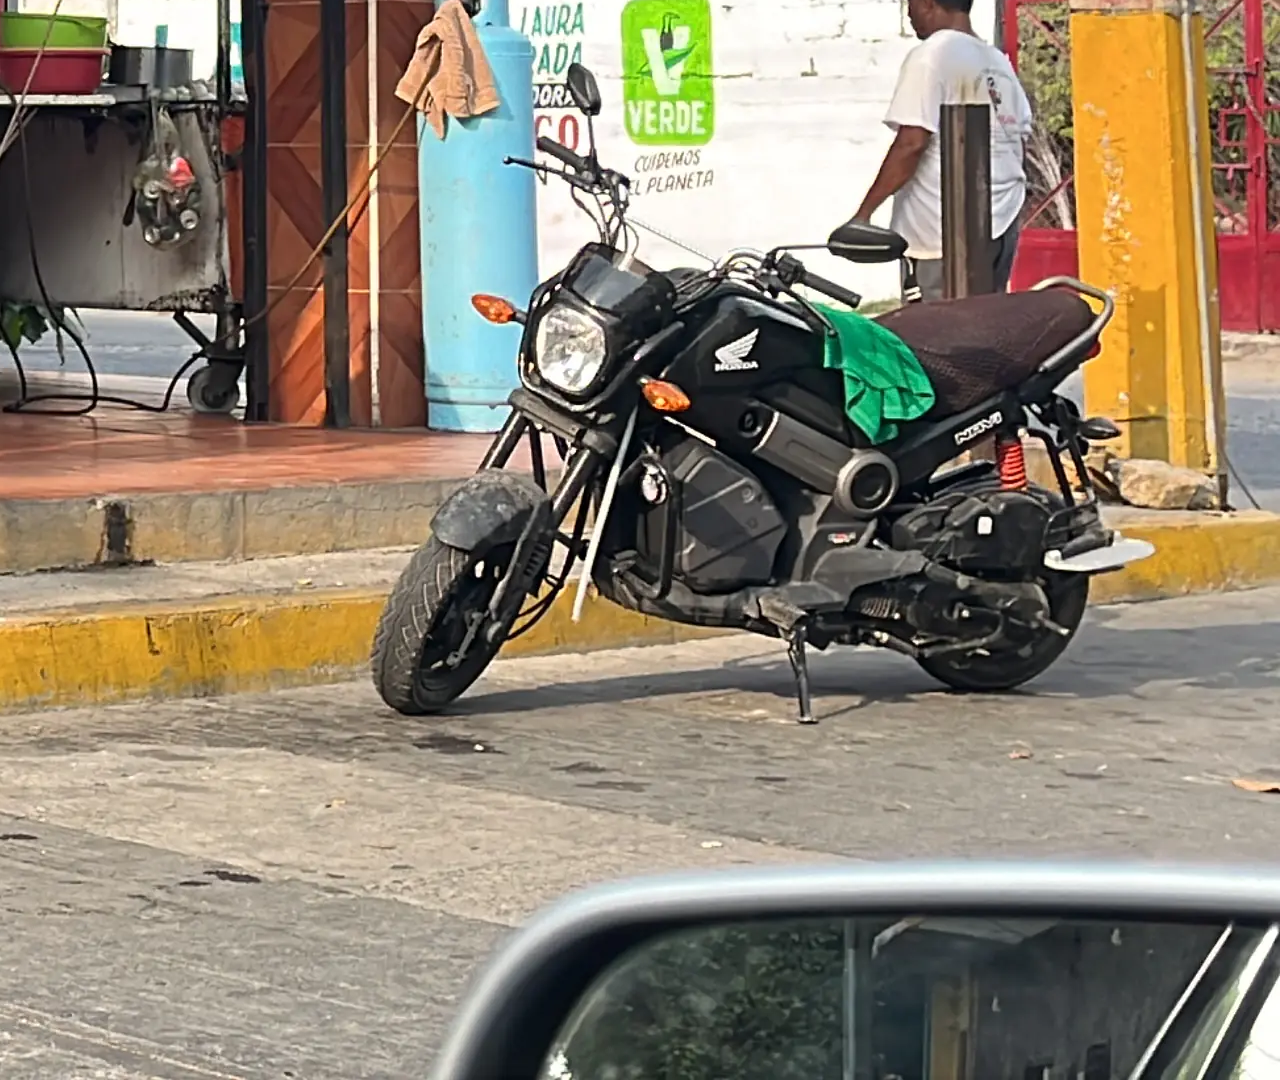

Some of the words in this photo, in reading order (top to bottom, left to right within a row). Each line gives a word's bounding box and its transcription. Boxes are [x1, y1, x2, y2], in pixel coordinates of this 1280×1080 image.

[627, 99, 706, 136] VERDE
[634, 148, 701, 174] CUIDEMOS
[646, 170, 715, 195] PLANETA
[713, 360, 760, 373] HONDA
[953, 410, 1004, 446] NAVI
